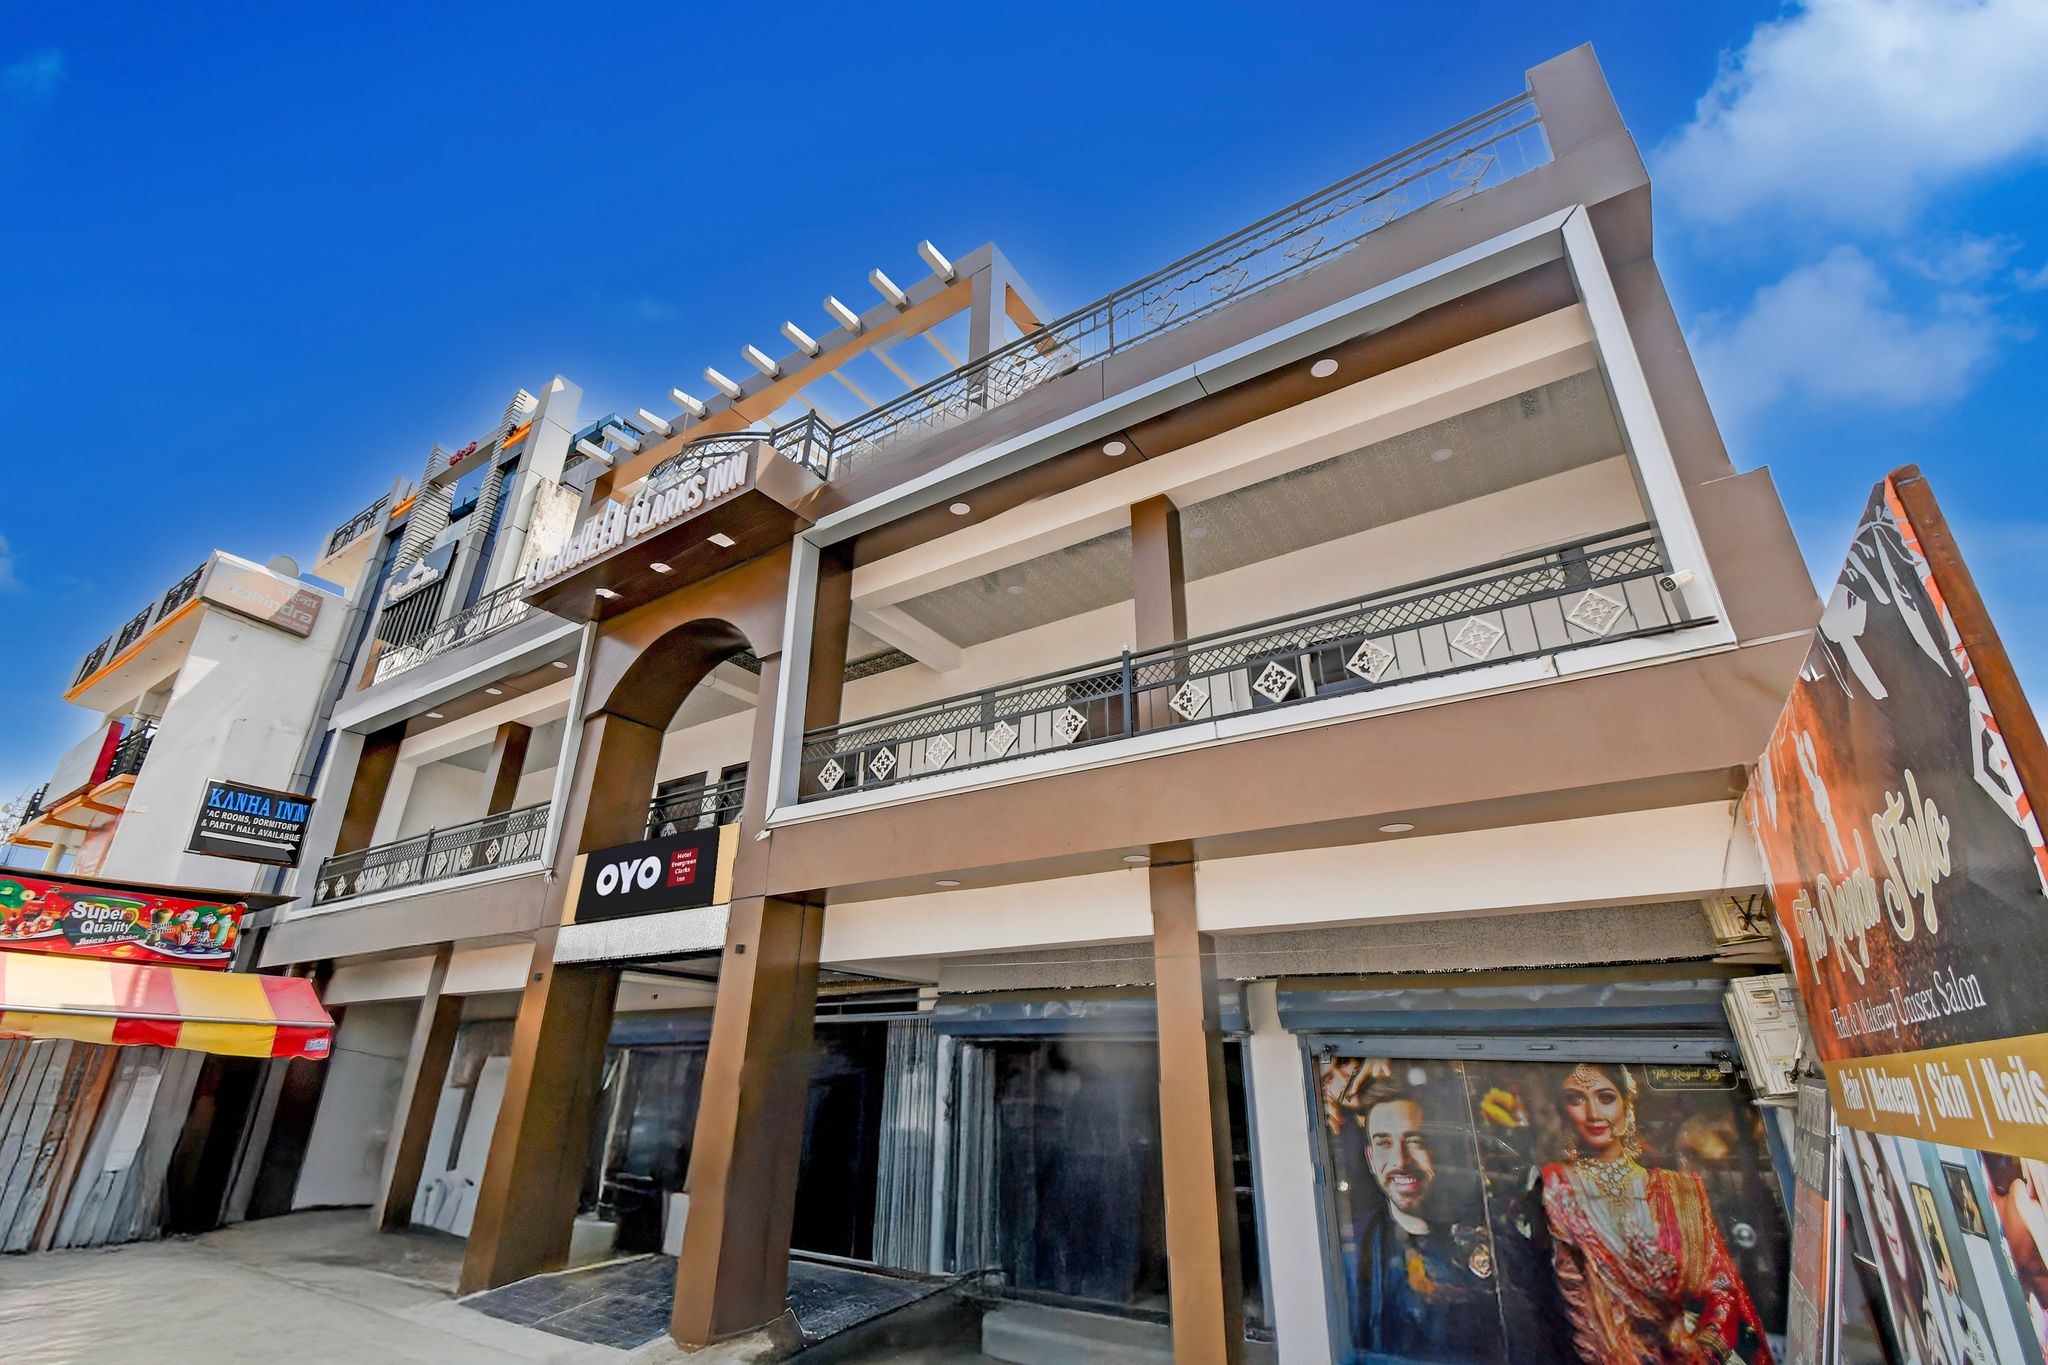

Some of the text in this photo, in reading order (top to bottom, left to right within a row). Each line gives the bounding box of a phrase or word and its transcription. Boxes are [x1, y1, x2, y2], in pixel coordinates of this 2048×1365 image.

[626, 474, 706, 539] CLARKS
[705, 450, 749, 502] INN
[208, 787, 309, 822] KANHA INN
[201, 819, 208, 827] &
[209, 821, 236, 832] PARTY
[236, 825, 256, 836] HALL
[221, 811, 251, 826] ROOMS,
[671, 859, 697, 868] Evergreen
[674, 867, 691, 875] Clarks
[595, 855, 662, 897] OYO
[1817, 828, 1881, 985] Royal
[1872, 768, 1951, 942] Style
[71, 901, 127, 922] Super
[80, 920, 131, 934] Quality
[1855, 997, 1899, 1039] Makeup
[1890, 982, 1941, 1026] Unisex
[1933, 965, 1987, 1016] Salon
[1652, 1069, 1670, 1080] The
[1671, 1069, 1701, 1082] Royal
[1839, 1069, 1865, 1110] Hair
[1866, 1067, 1920, 1127] Makeup
[1925, 1062, 1974, 1119] Skin
[1979, 1055, 2048, 1126] Nails
